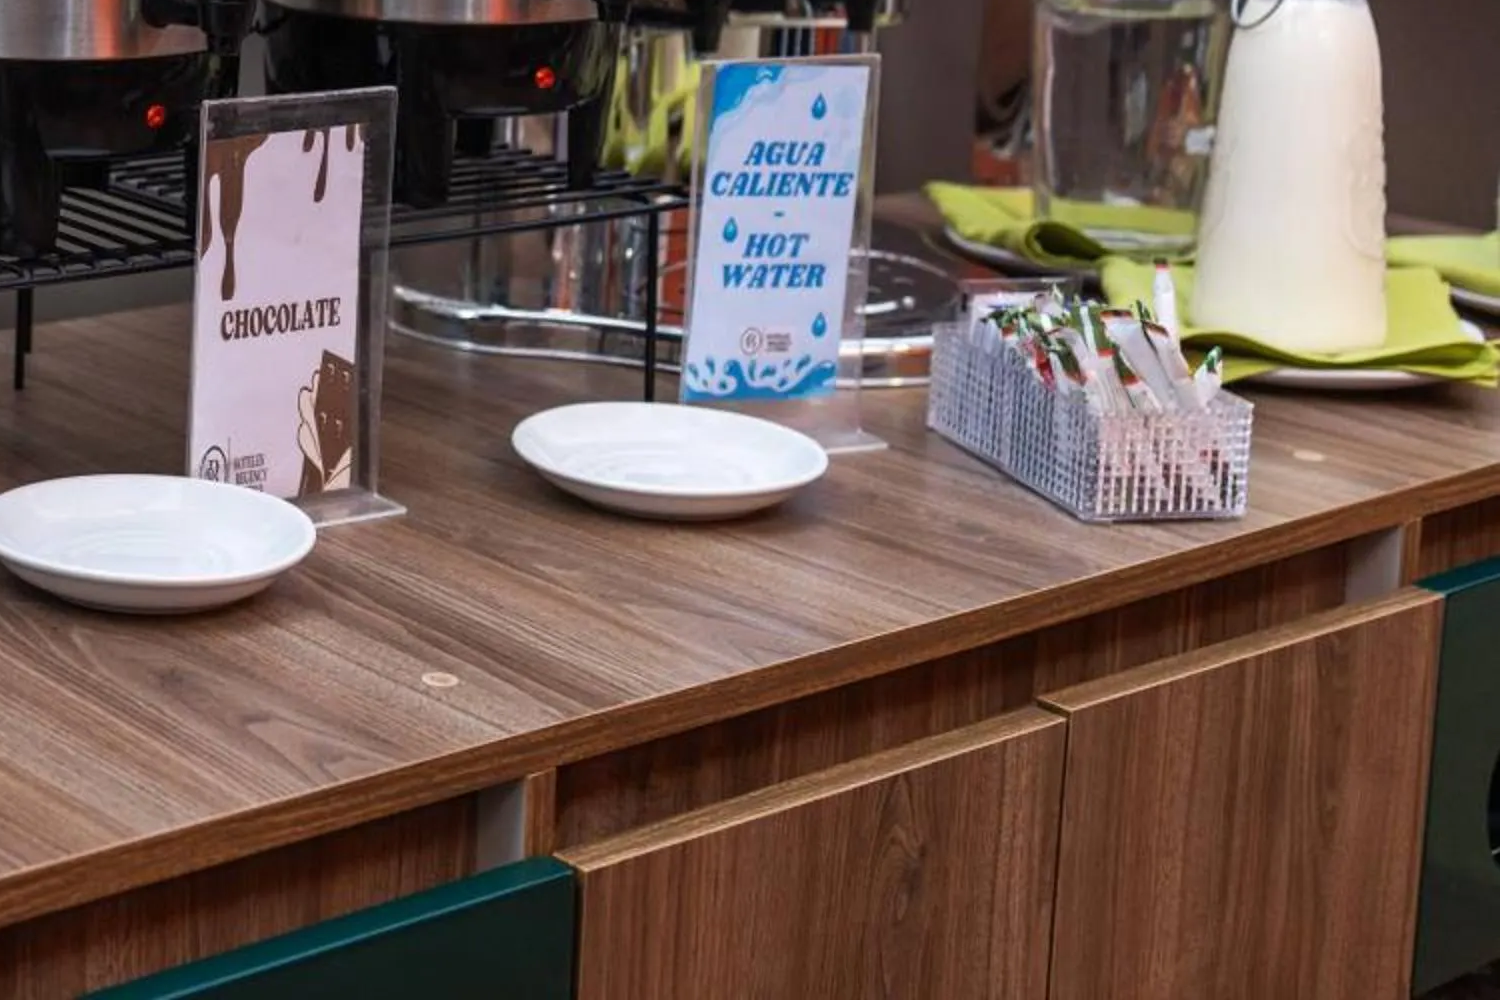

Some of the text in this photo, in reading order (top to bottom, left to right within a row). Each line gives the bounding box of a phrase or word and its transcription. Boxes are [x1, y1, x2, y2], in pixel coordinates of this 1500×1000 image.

[744, 141, 826, 167] AGUA
[710, 172, 854, 198] CALIENTE
[743, 233, 810, 258] HOT
[722, 264, 826, 289] WATER
[221, 297, 341, 341] CHOCOLATE
